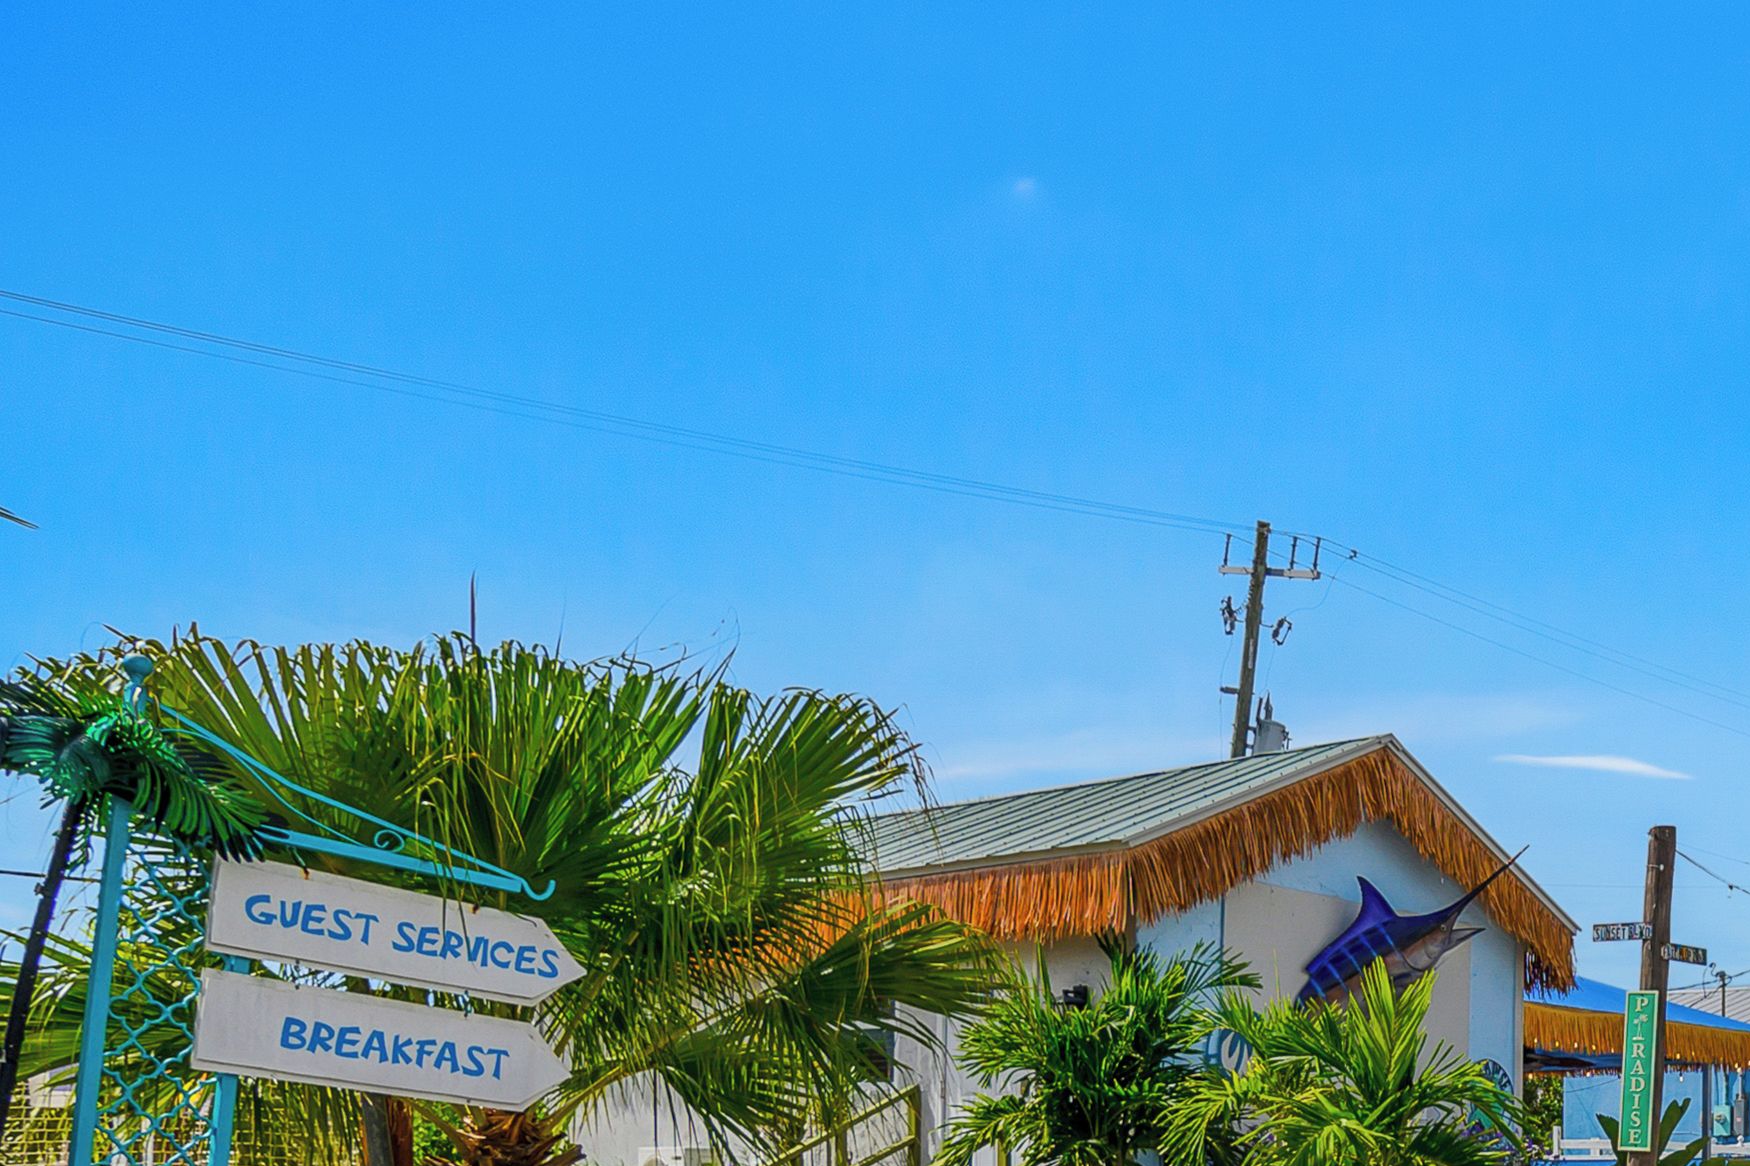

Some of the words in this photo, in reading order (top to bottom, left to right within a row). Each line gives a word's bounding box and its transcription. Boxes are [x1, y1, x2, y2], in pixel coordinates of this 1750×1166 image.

[245, 894, 379, 945] GUEST
[392, 921, 560, 979] SERVICES
[1595, 925, 1627, 940] SUNSET
[279, 1016, 510, 1080] BREAKFAST
[1628, 996, 1649, 1146] PRADISE
